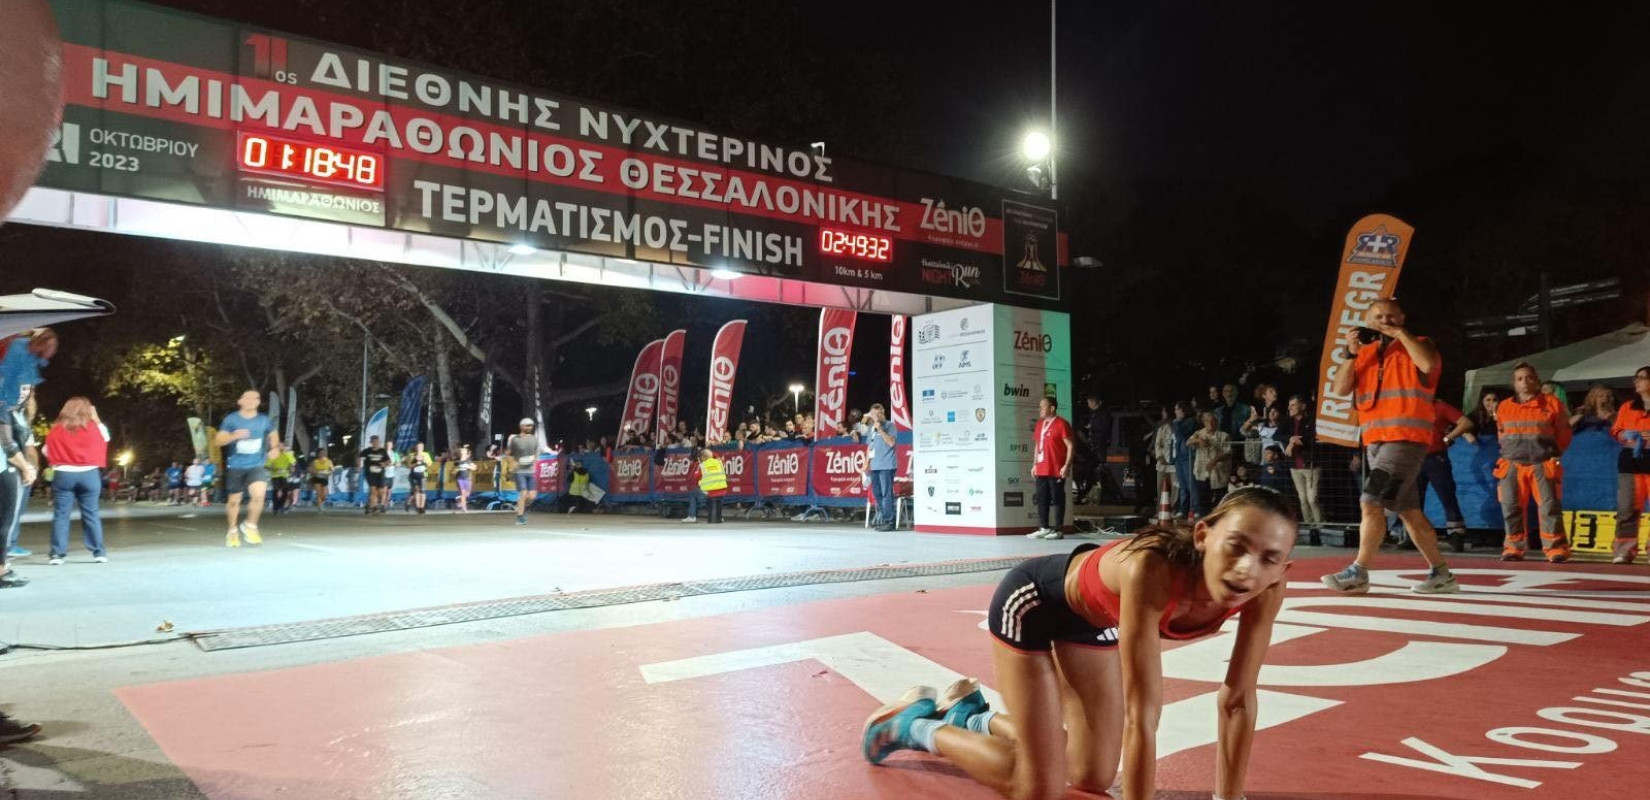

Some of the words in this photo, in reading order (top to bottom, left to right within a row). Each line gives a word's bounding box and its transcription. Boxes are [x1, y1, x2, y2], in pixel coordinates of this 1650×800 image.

[310, 52, 561, 131] ΔΙΕΘΝΗΣ
[579, 107, 833, 183] ΝΥΧΤΕΡΙΝΟΣ
[90, 128, 199, 158] ΟΚΤΩΒΡΙΟΥ
[92, 57, 604, 183] ΗΜΙΜΑΡΑΘΩΝΙΟΣ
[619, 157, 901, 232] ΘΕΣΣΑΛΟΝΙΚΗΣ
[89, 151, 140, 172] 2023
[247, 186, 381, 213] ΗΜΙΜΑΡΑΘΩΝΙΟΣ
[857, 269, 863, 278] &
[1003, 383, 1030, 398] bwin
